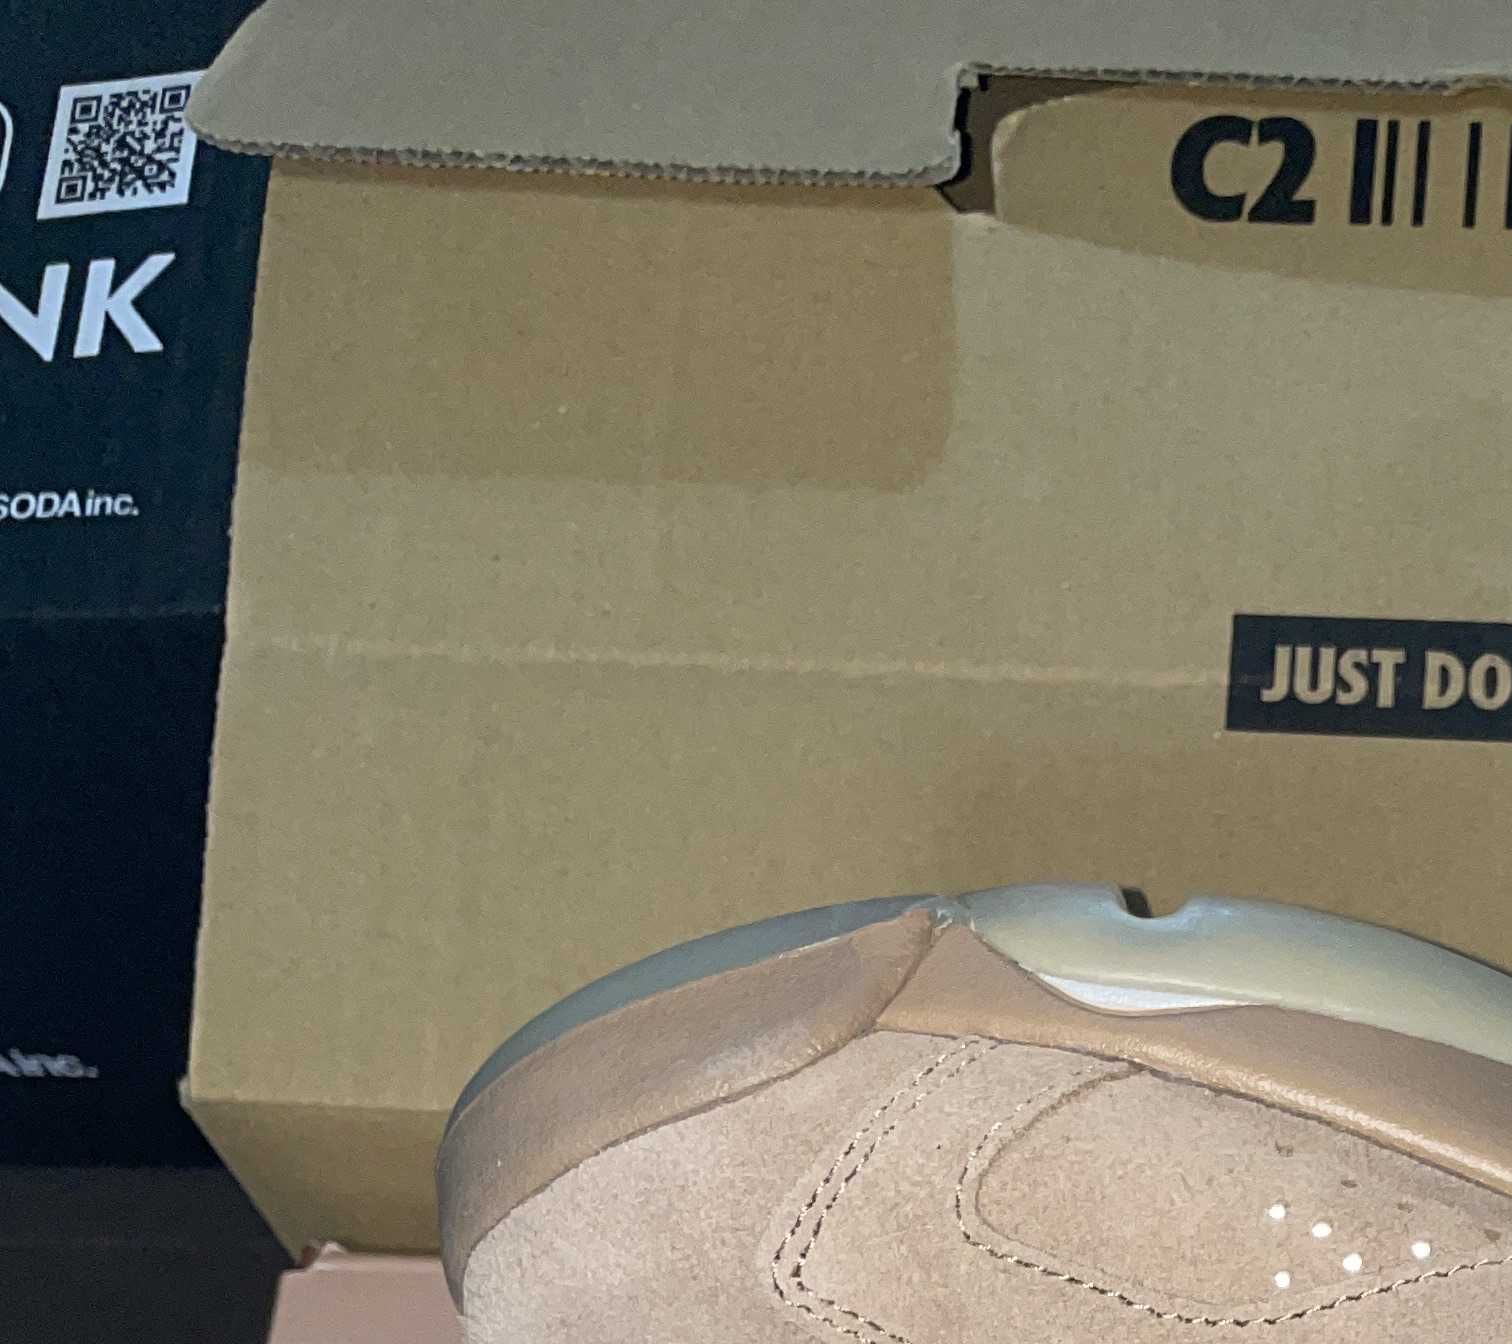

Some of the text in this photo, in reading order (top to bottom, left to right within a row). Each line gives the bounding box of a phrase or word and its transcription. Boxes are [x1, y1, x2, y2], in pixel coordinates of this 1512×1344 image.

[1170, 114, 1317, 225] C2
[84, 488, 140, 517] inc.
[1260, 644, 1406, 708] JUST
